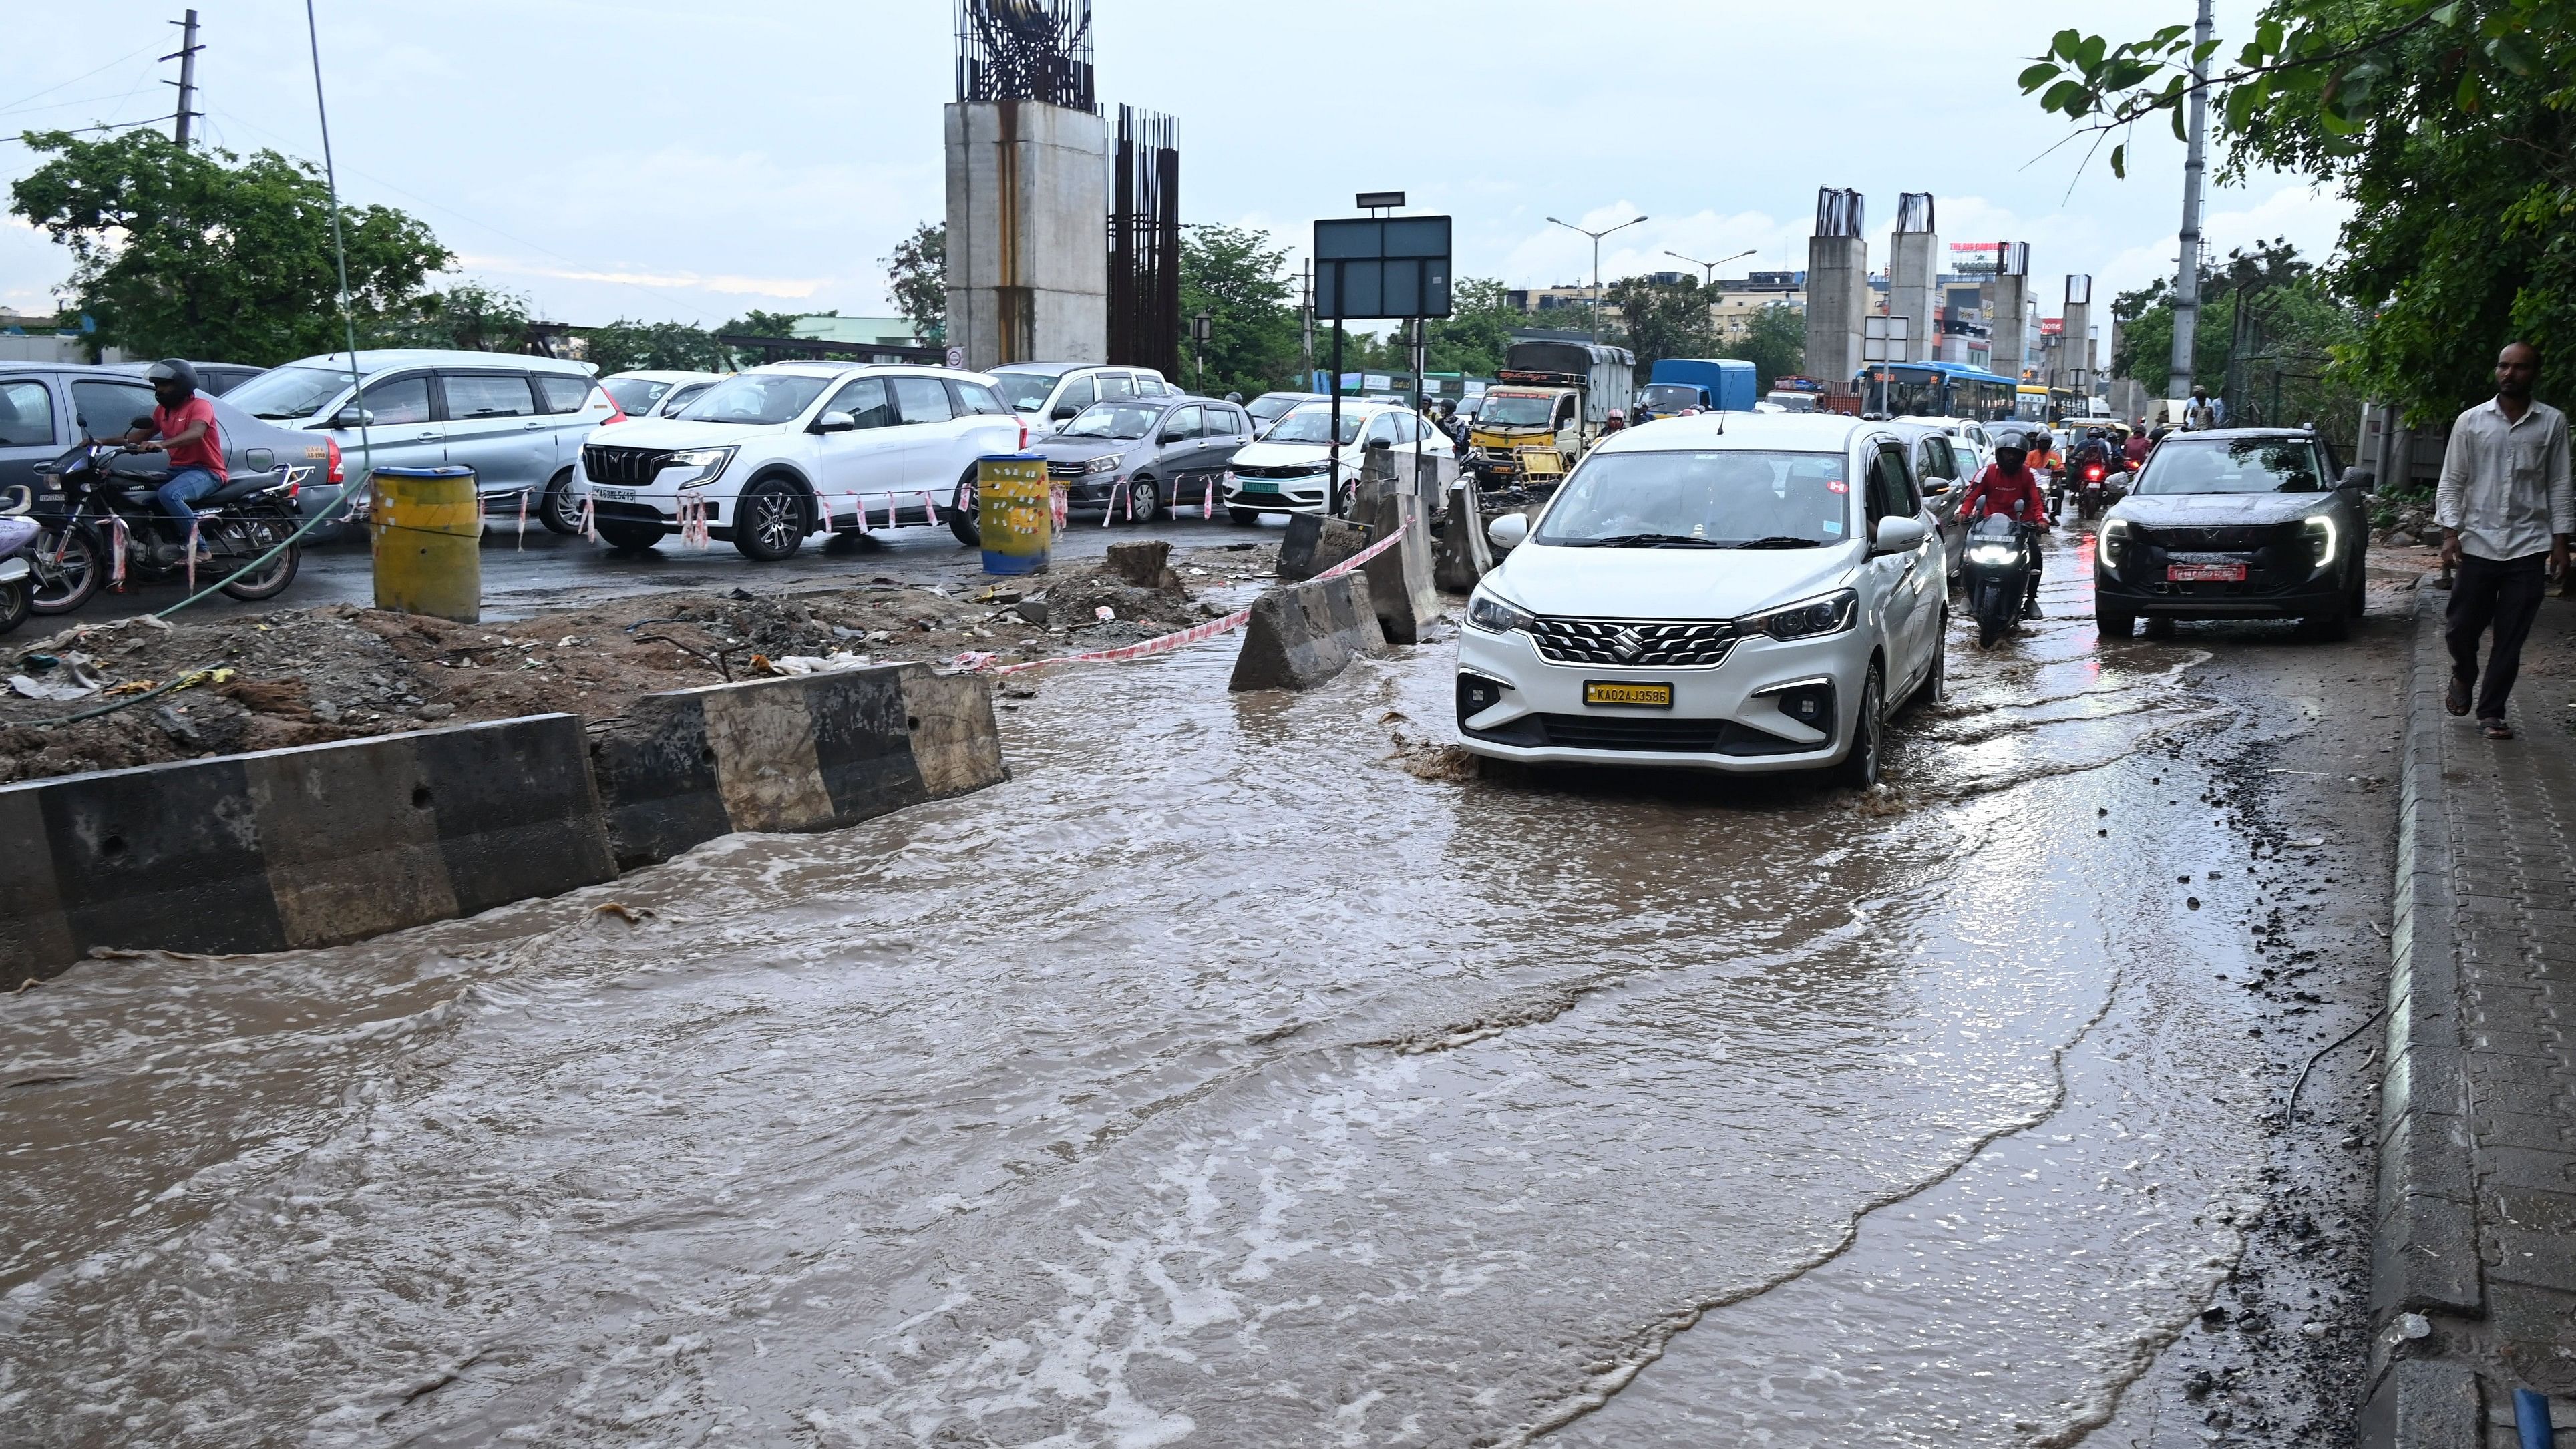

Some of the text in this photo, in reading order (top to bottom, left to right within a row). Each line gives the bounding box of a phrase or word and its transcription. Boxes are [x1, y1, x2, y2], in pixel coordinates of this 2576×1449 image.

[2042, 321, 2061, 330] home
[1830, 481, 1844, 491] H
[1598, 689, 1666, 702] KA02AJ3586
